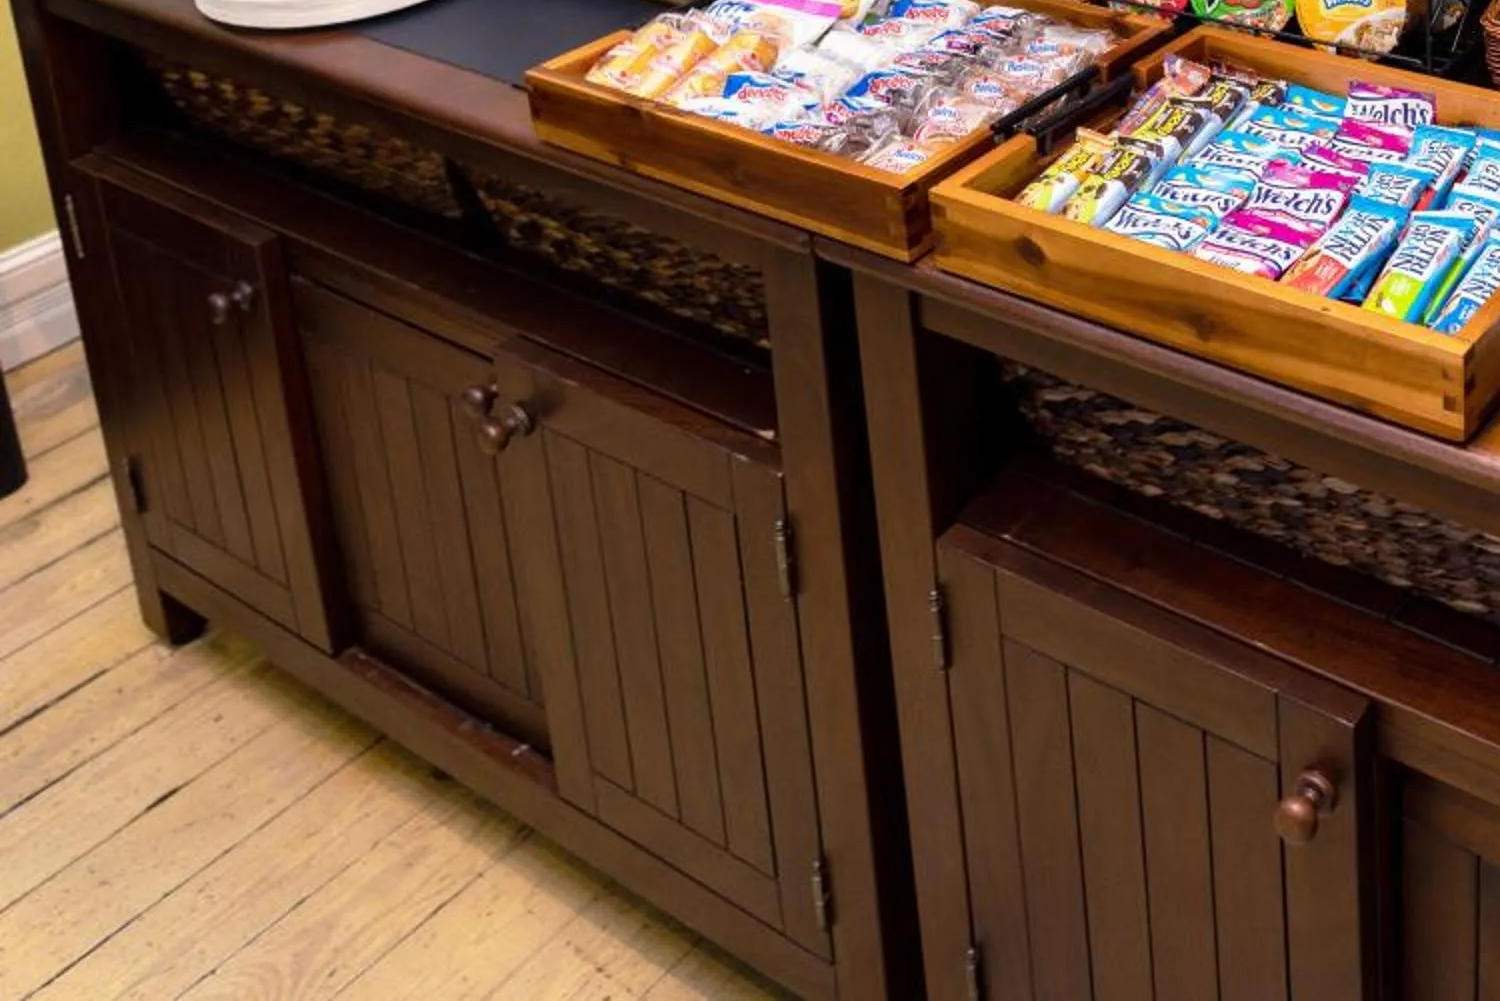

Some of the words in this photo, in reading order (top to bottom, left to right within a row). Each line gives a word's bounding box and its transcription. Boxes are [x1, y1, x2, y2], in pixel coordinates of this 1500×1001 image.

[1351, 101, 1429, 126] Welch's
[1254, 186, 1336, 216] Welch's
[1340, 216, 1389, 263] NUTRI
[1392, 223, 1430, 272] GRAIN
[1411, 227, 1450, 276] NUTRI
